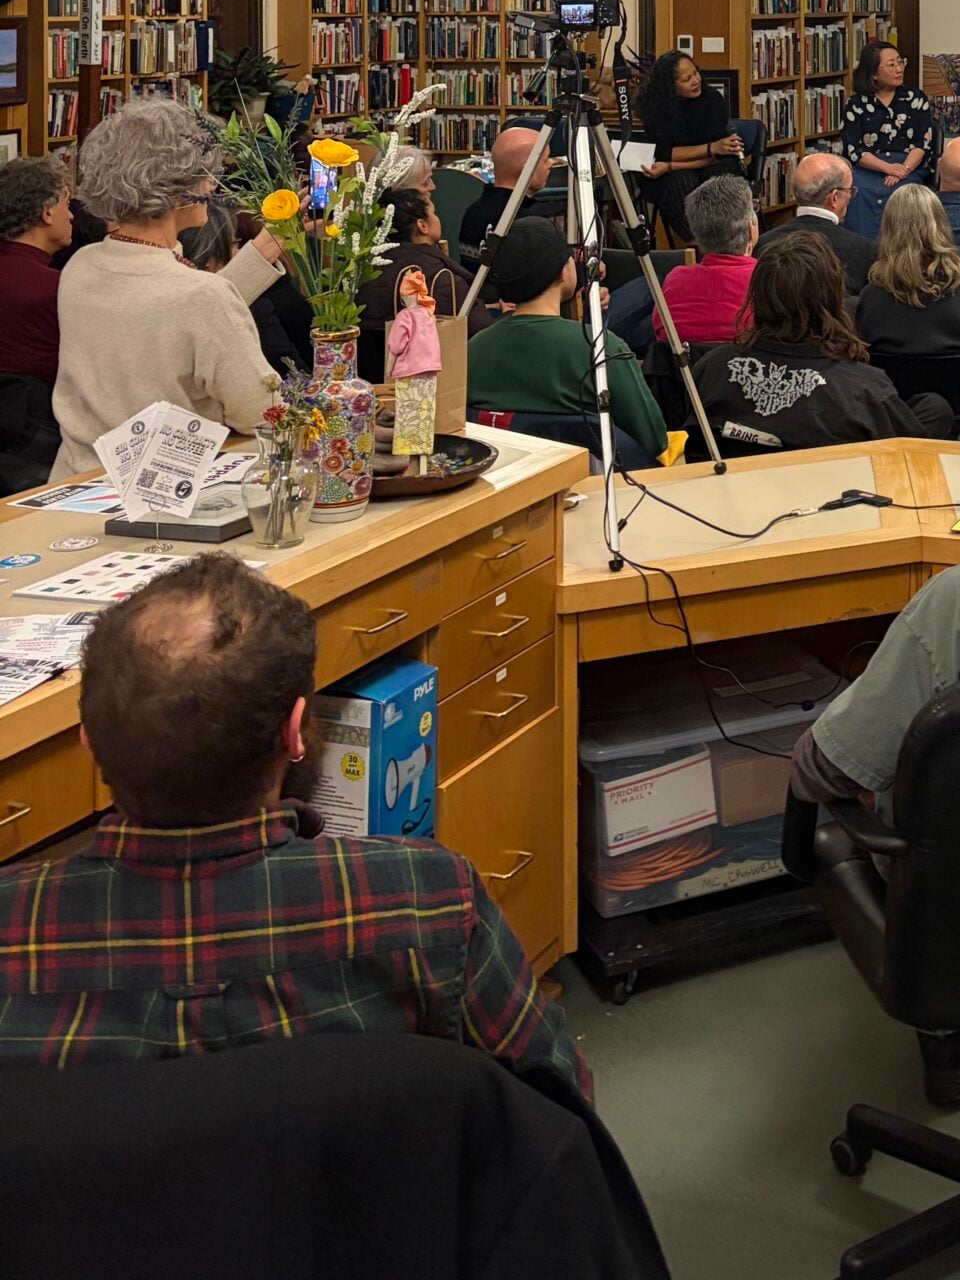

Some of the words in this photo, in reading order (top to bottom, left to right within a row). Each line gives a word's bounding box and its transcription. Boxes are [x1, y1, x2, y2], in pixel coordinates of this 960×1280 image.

[81, 16, 90, 30] On
[81, 33, 89, 59] Earth
[618, 86, 630, 121] SONY
[729, 427, 759, 443] BRING
[413, 677, 435, 702] PYLE
[348, 755, 358, 763] 30
[345, 767, 361, 776] MAX
[609, 781, 655, 801] PRIORITY
[620, 793, 645, 804] MAIL
